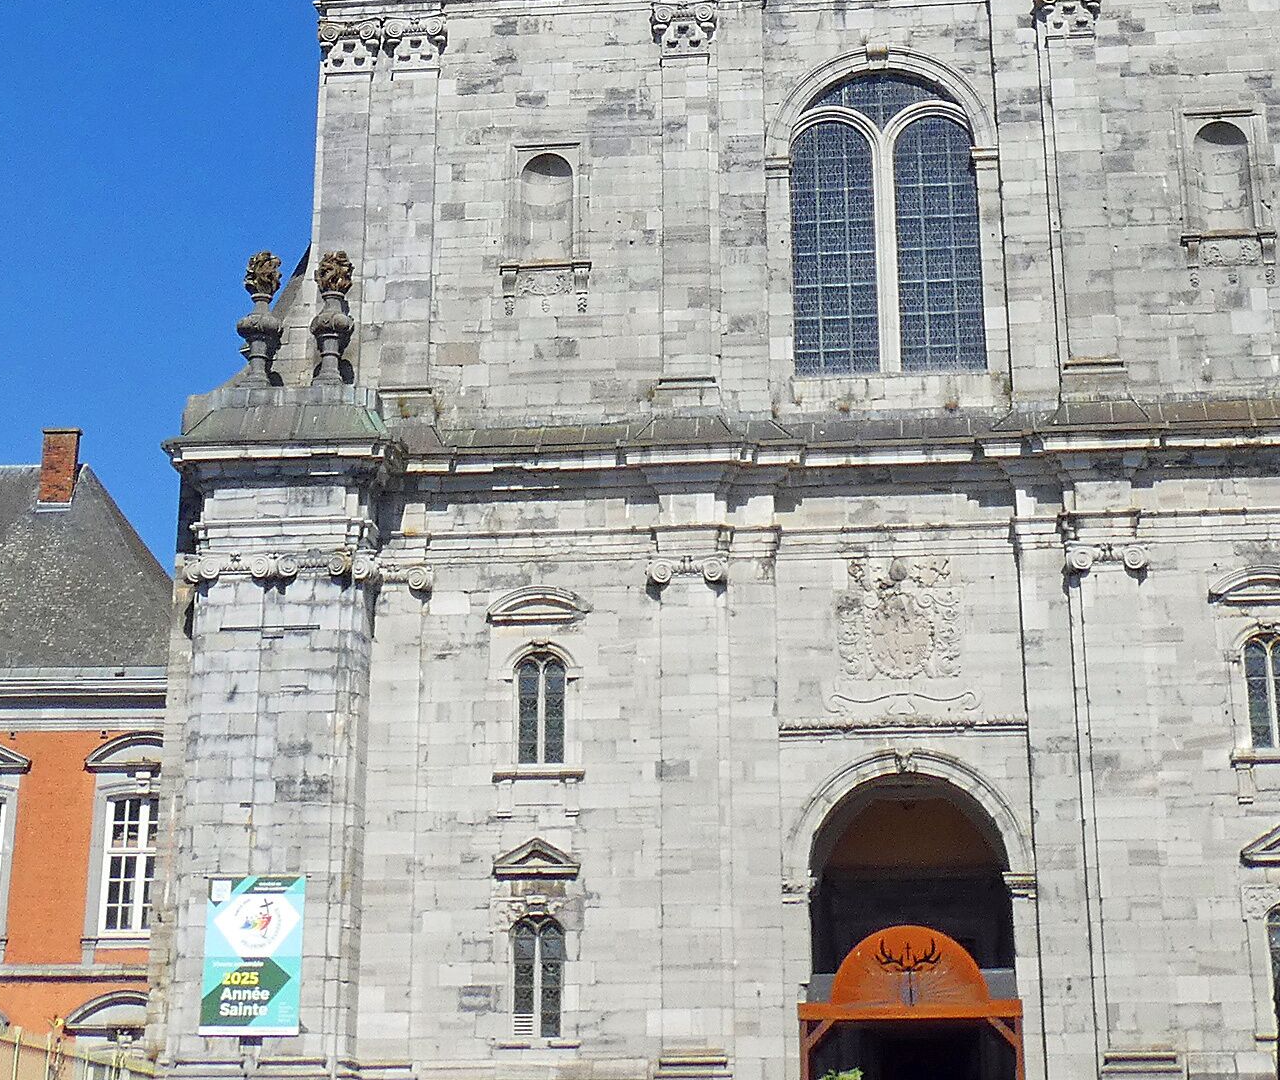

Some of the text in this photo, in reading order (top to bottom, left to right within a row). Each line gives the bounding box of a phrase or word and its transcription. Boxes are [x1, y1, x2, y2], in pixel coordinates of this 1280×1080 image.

[222, 971, 260, 986] 2025
[220, 986, 270, 1001] Année
[219, 1002, 268, 1017] Sainte
